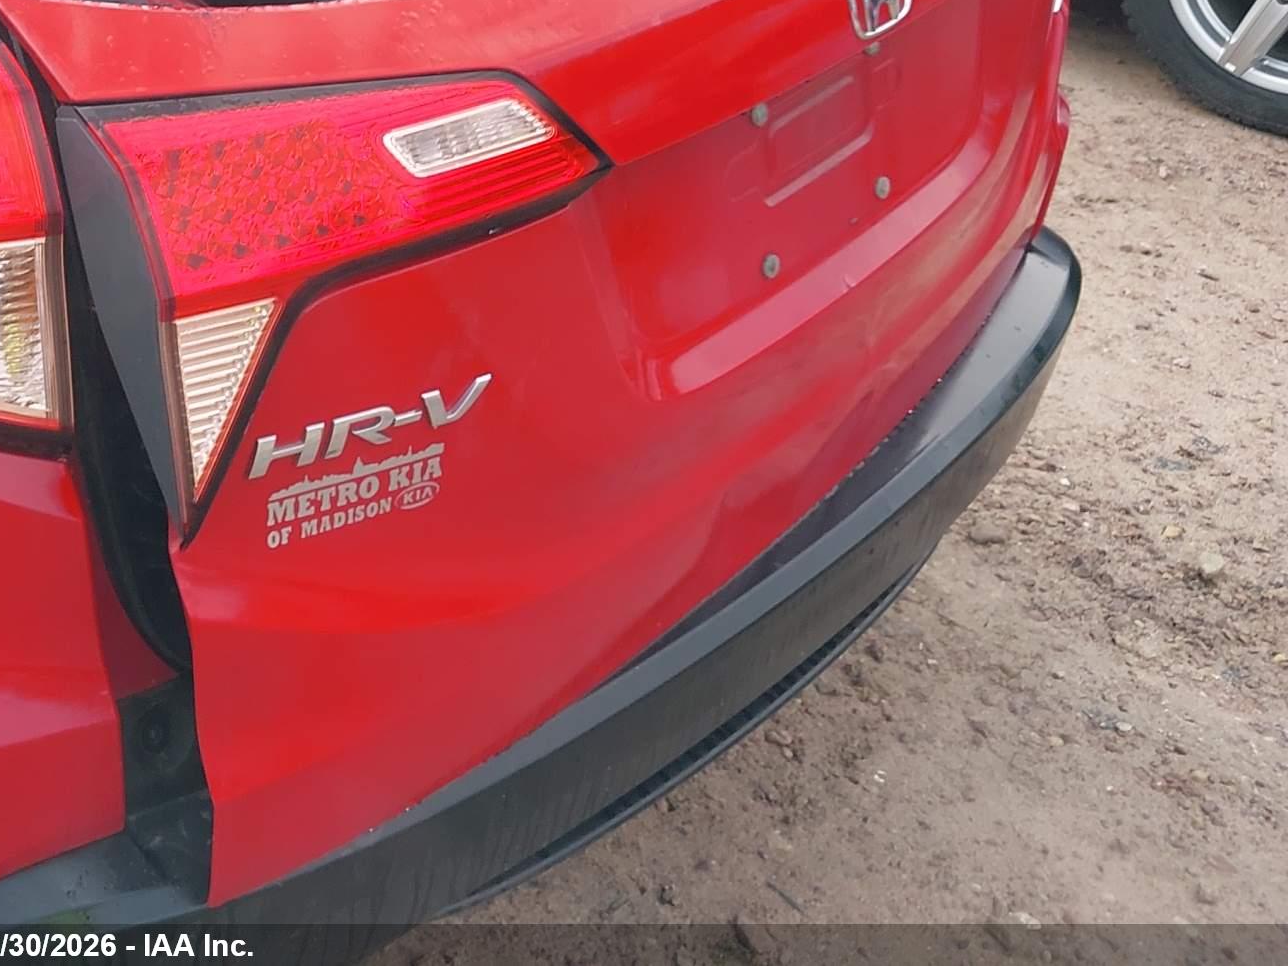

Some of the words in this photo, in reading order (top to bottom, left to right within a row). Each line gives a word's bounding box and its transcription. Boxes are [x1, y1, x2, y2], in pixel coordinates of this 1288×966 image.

[248, 373, 492, 480] HR-V
[266, 475, 380, 526] METRO
[388, 456, 442, 491] KIA
[402, 485, 434, 505] KIA
[267, 526, 292, 549] OF
[301, 497, 393, 539] MADISON
